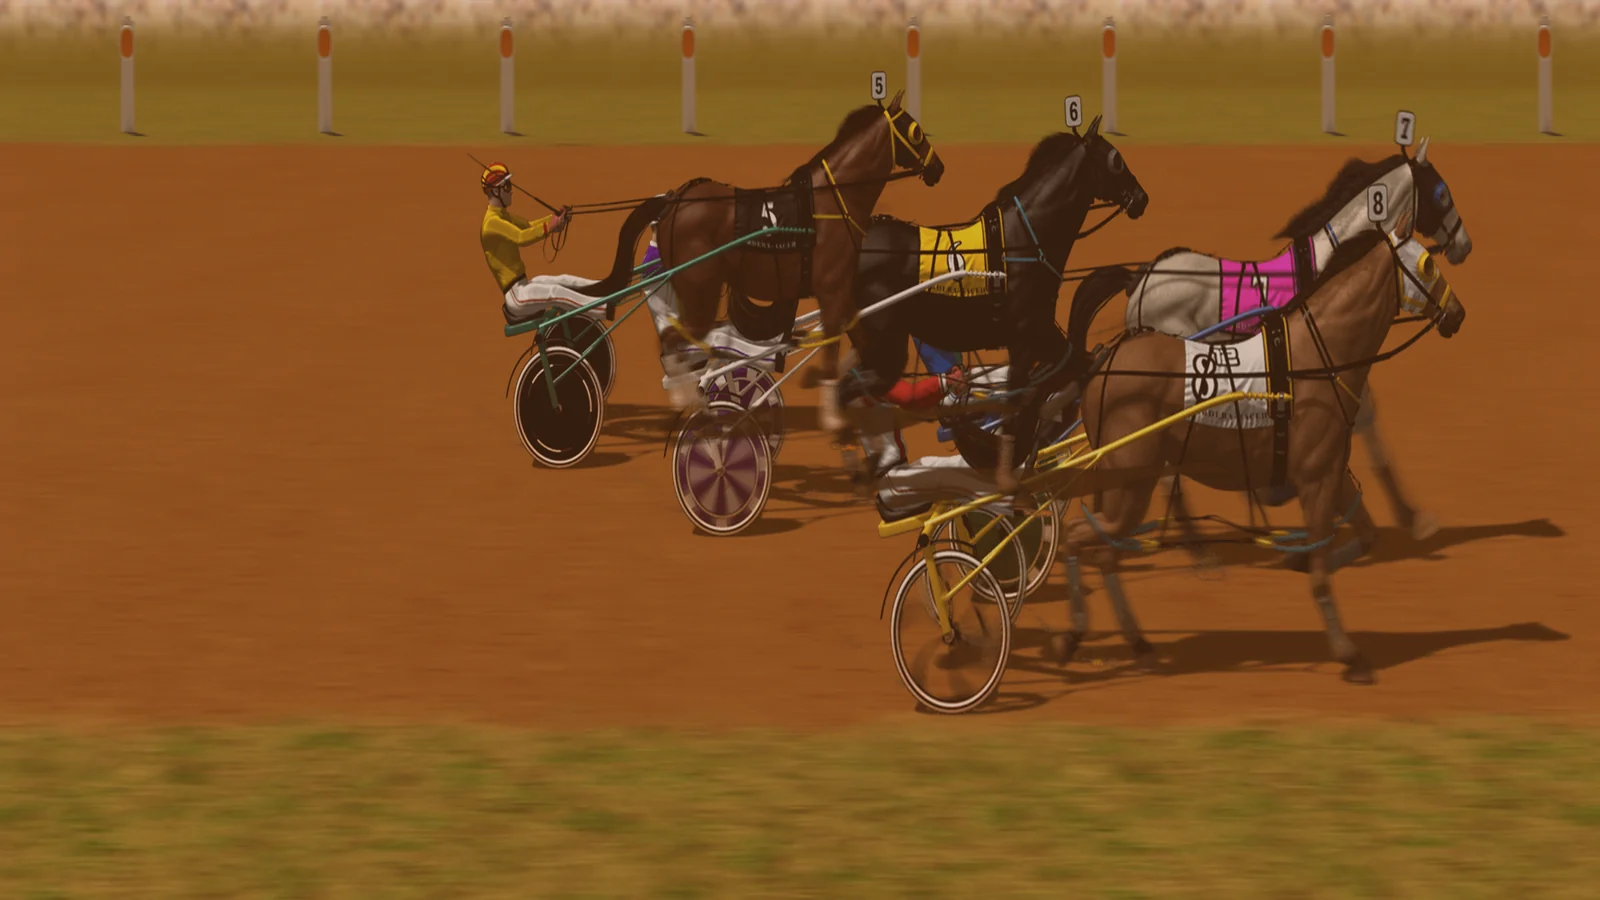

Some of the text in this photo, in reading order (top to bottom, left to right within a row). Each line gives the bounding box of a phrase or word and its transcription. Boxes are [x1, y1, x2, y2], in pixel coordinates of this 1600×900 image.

[875, 76, 883, 95] 5
[1069, 101, 1078, 121] 6
[1401, 117, 1411, 140] 7
[1373, 190, 1384, 215] 8
[761, 201, 777, 237] 5
[947, 240, 966, 281] 6
[1191, 353, 1218, 402] 8
